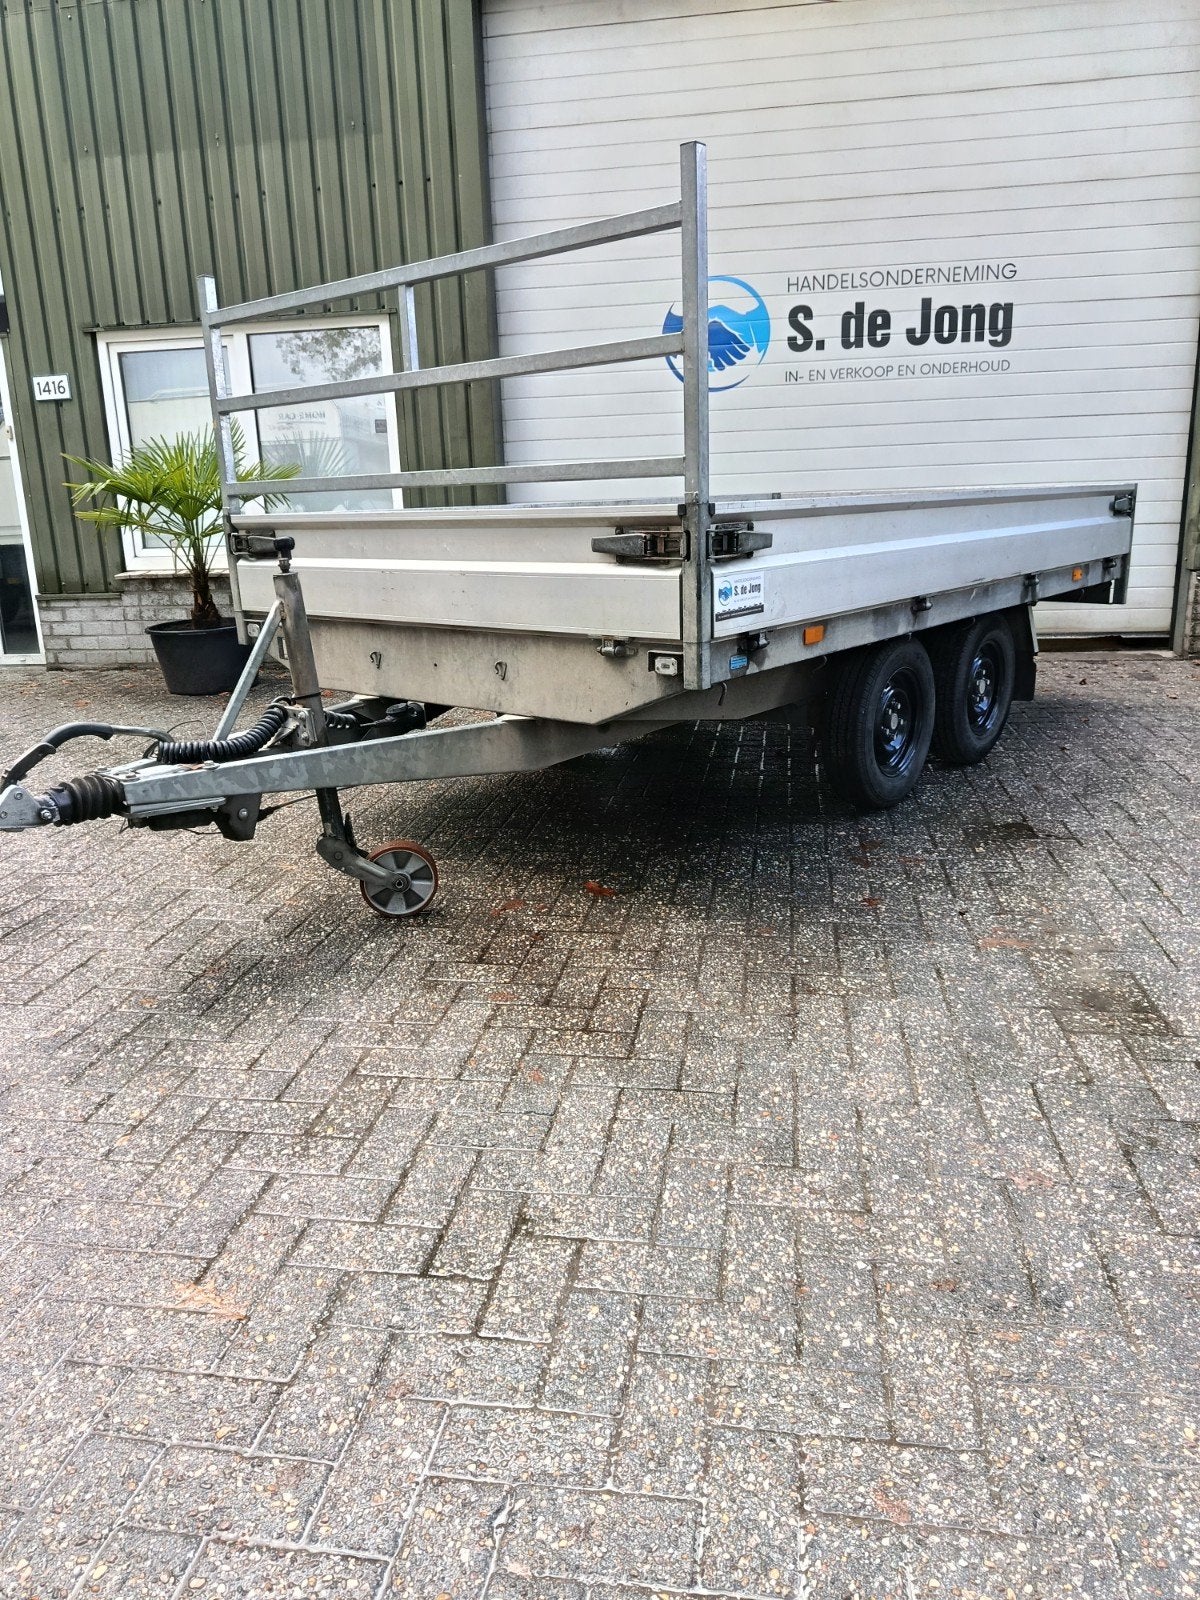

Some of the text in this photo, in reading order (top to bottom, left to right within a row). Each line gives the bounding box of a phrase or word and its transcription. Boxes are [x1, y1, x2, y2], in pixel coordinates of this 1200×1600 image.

[787, 263, 1017, 292] HANDELSONDERNEMING
[787, 298, 1014, 352] S. de Jong
[785, 359, 1011, 382] IN- EN VERKOOP EN ONDERHOUD
[37, 380, 66, 395] 1416
[741, 585, 747, 595] de
[749, 583, 761, 593] Jong
